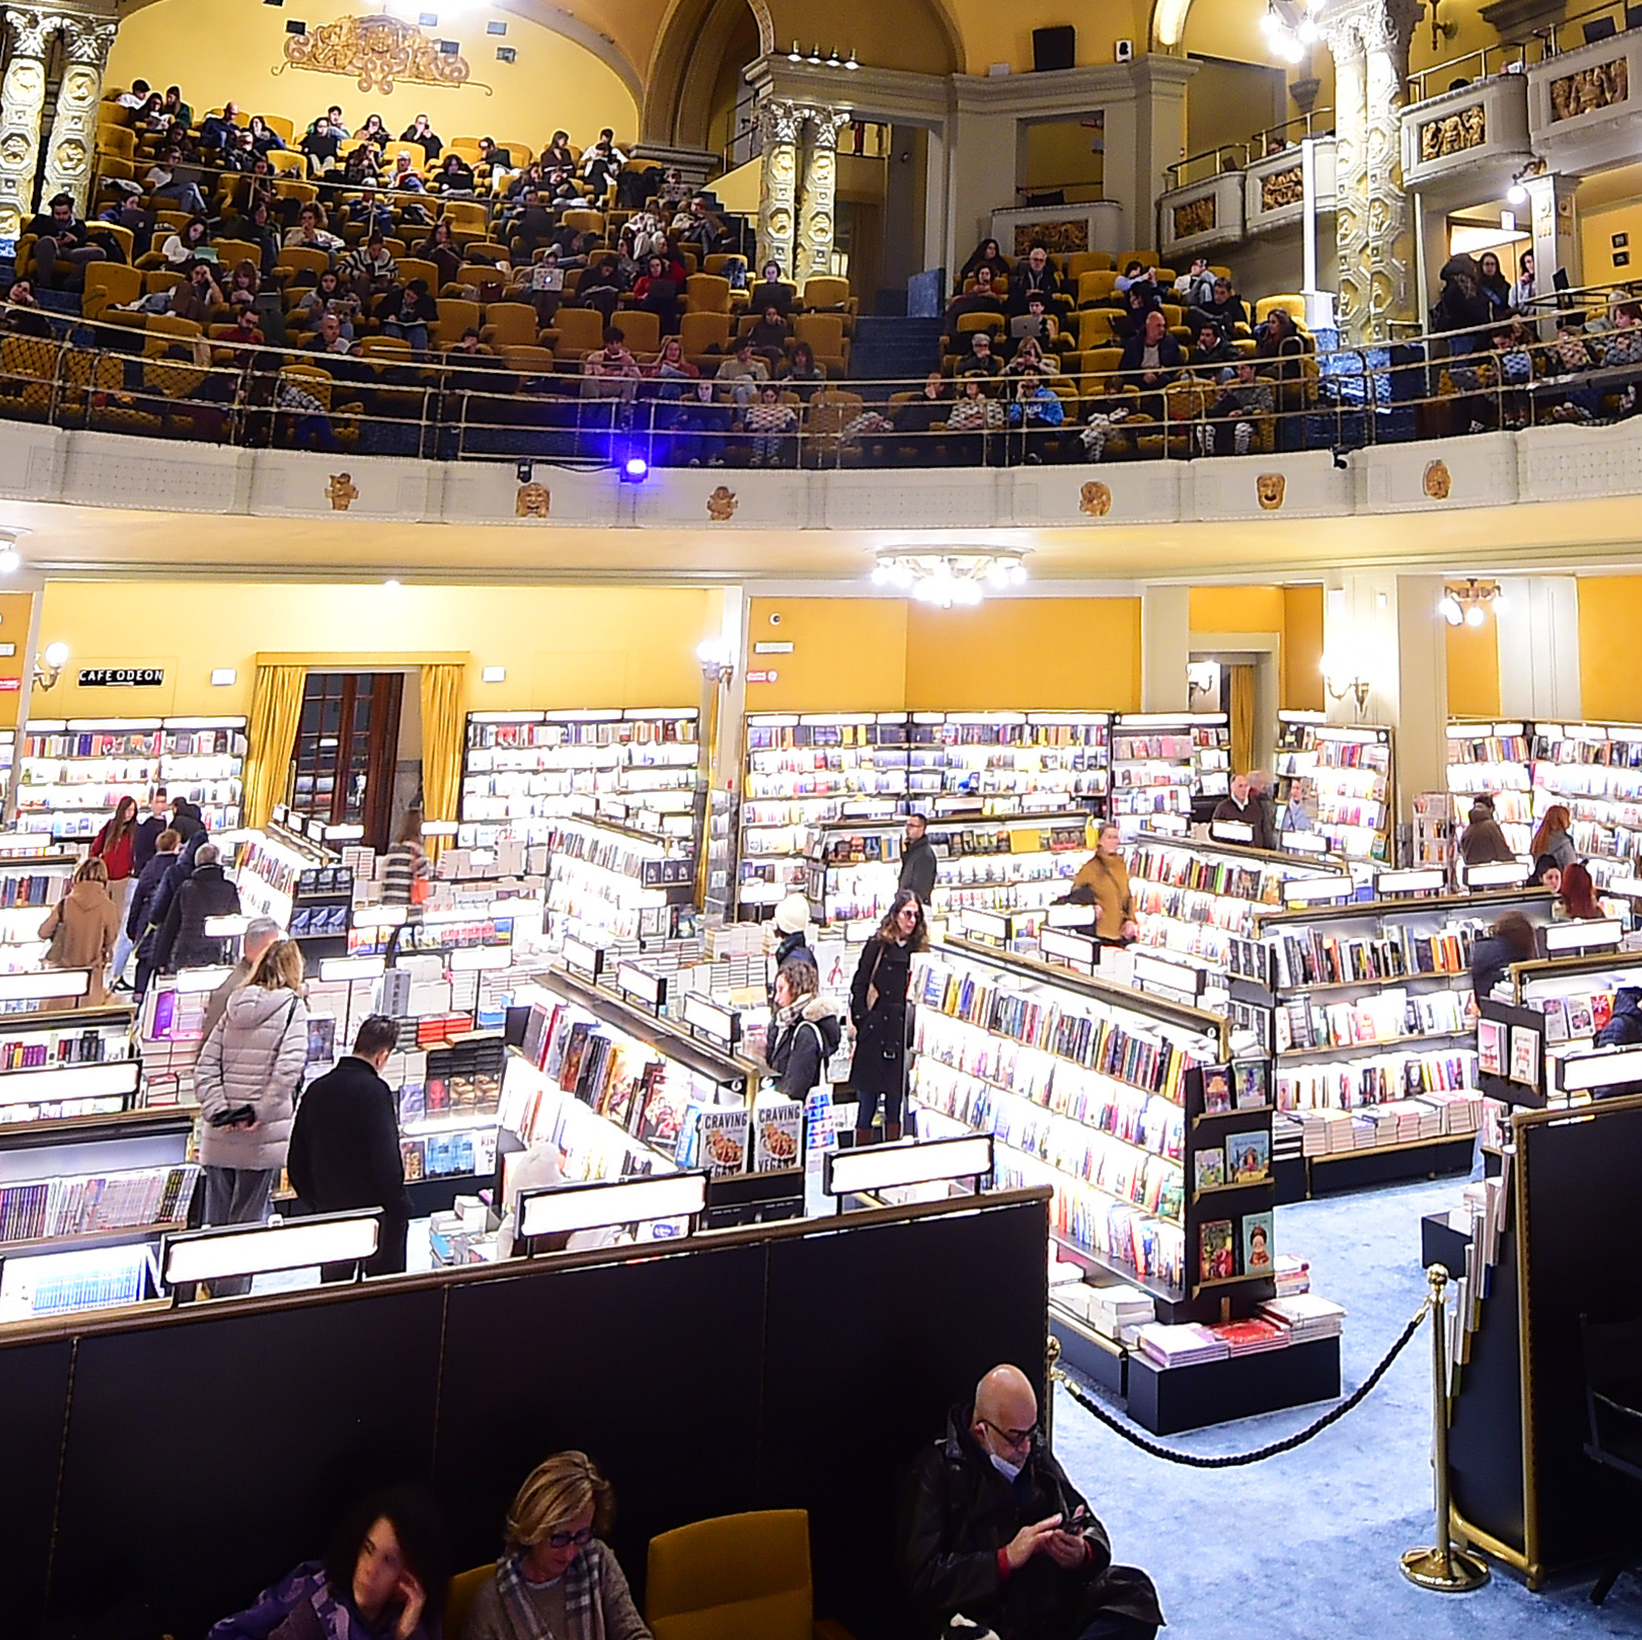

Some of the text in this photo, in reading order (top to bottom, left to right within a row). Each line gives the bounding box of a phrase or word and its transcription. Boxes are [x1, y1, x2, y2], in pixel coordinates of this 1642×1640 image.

[79, 669, 163, 682] CAFE ODEON
[704, 1113, 748, 1130] CRAVING
[758, 1106, 801, 1124] CRAVING
